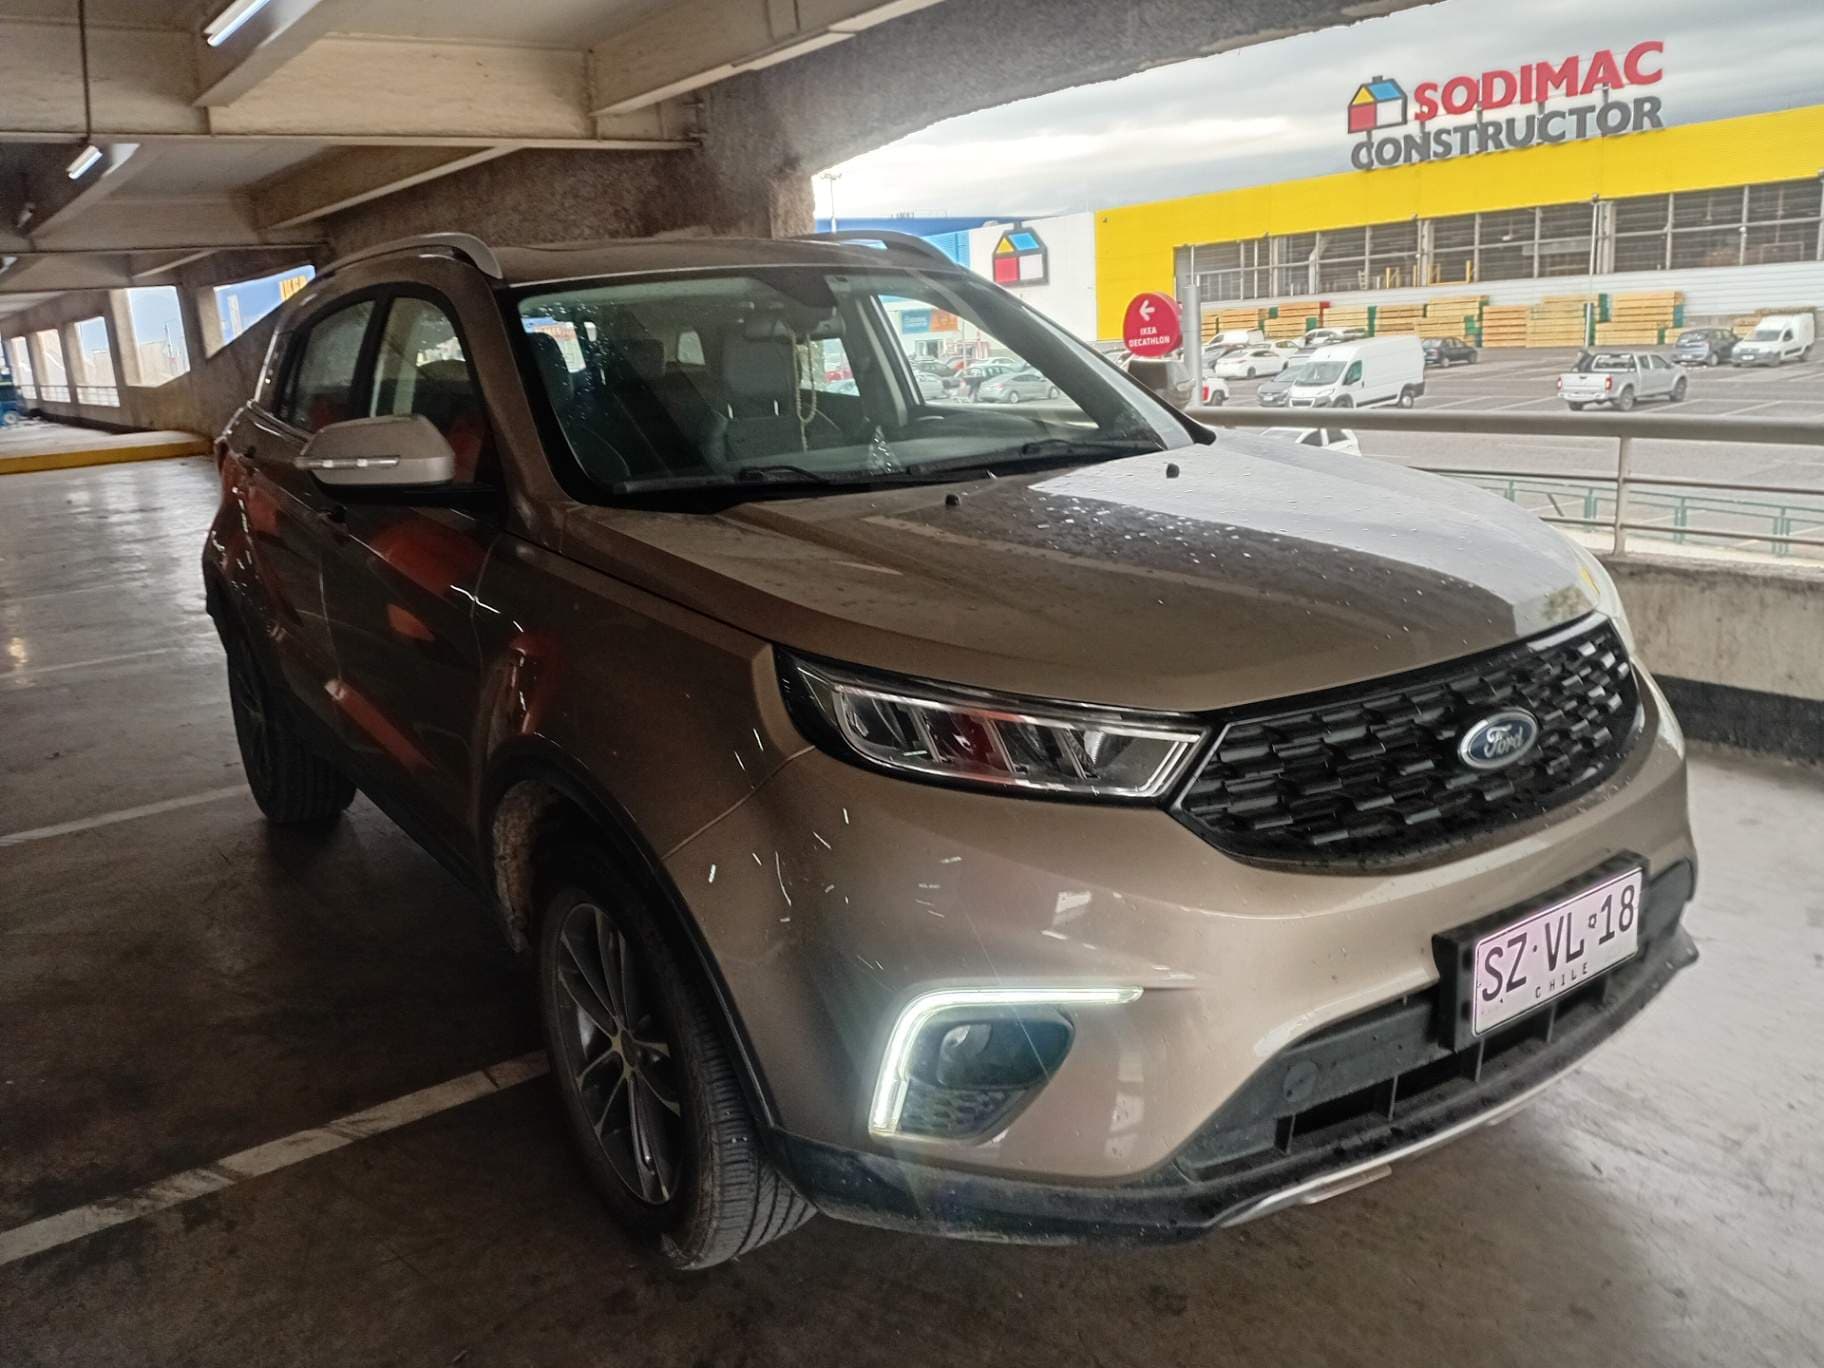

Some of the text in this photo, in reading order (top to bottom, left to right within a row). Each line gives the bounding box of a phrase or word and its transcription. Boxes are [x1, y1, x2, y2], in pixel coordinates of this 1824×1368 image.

[1413, 40, 1664, 122] SODIMAC
[1350, 95, 1665, 171] CONSTRUCTOR
[1128, 336, 1170, 347] DECATHLON
[1140, 327, 1157, 336] IKEA
[1483, 724, 1524, 758] Ford
[1535, 962, 1588, 999] CHILE
